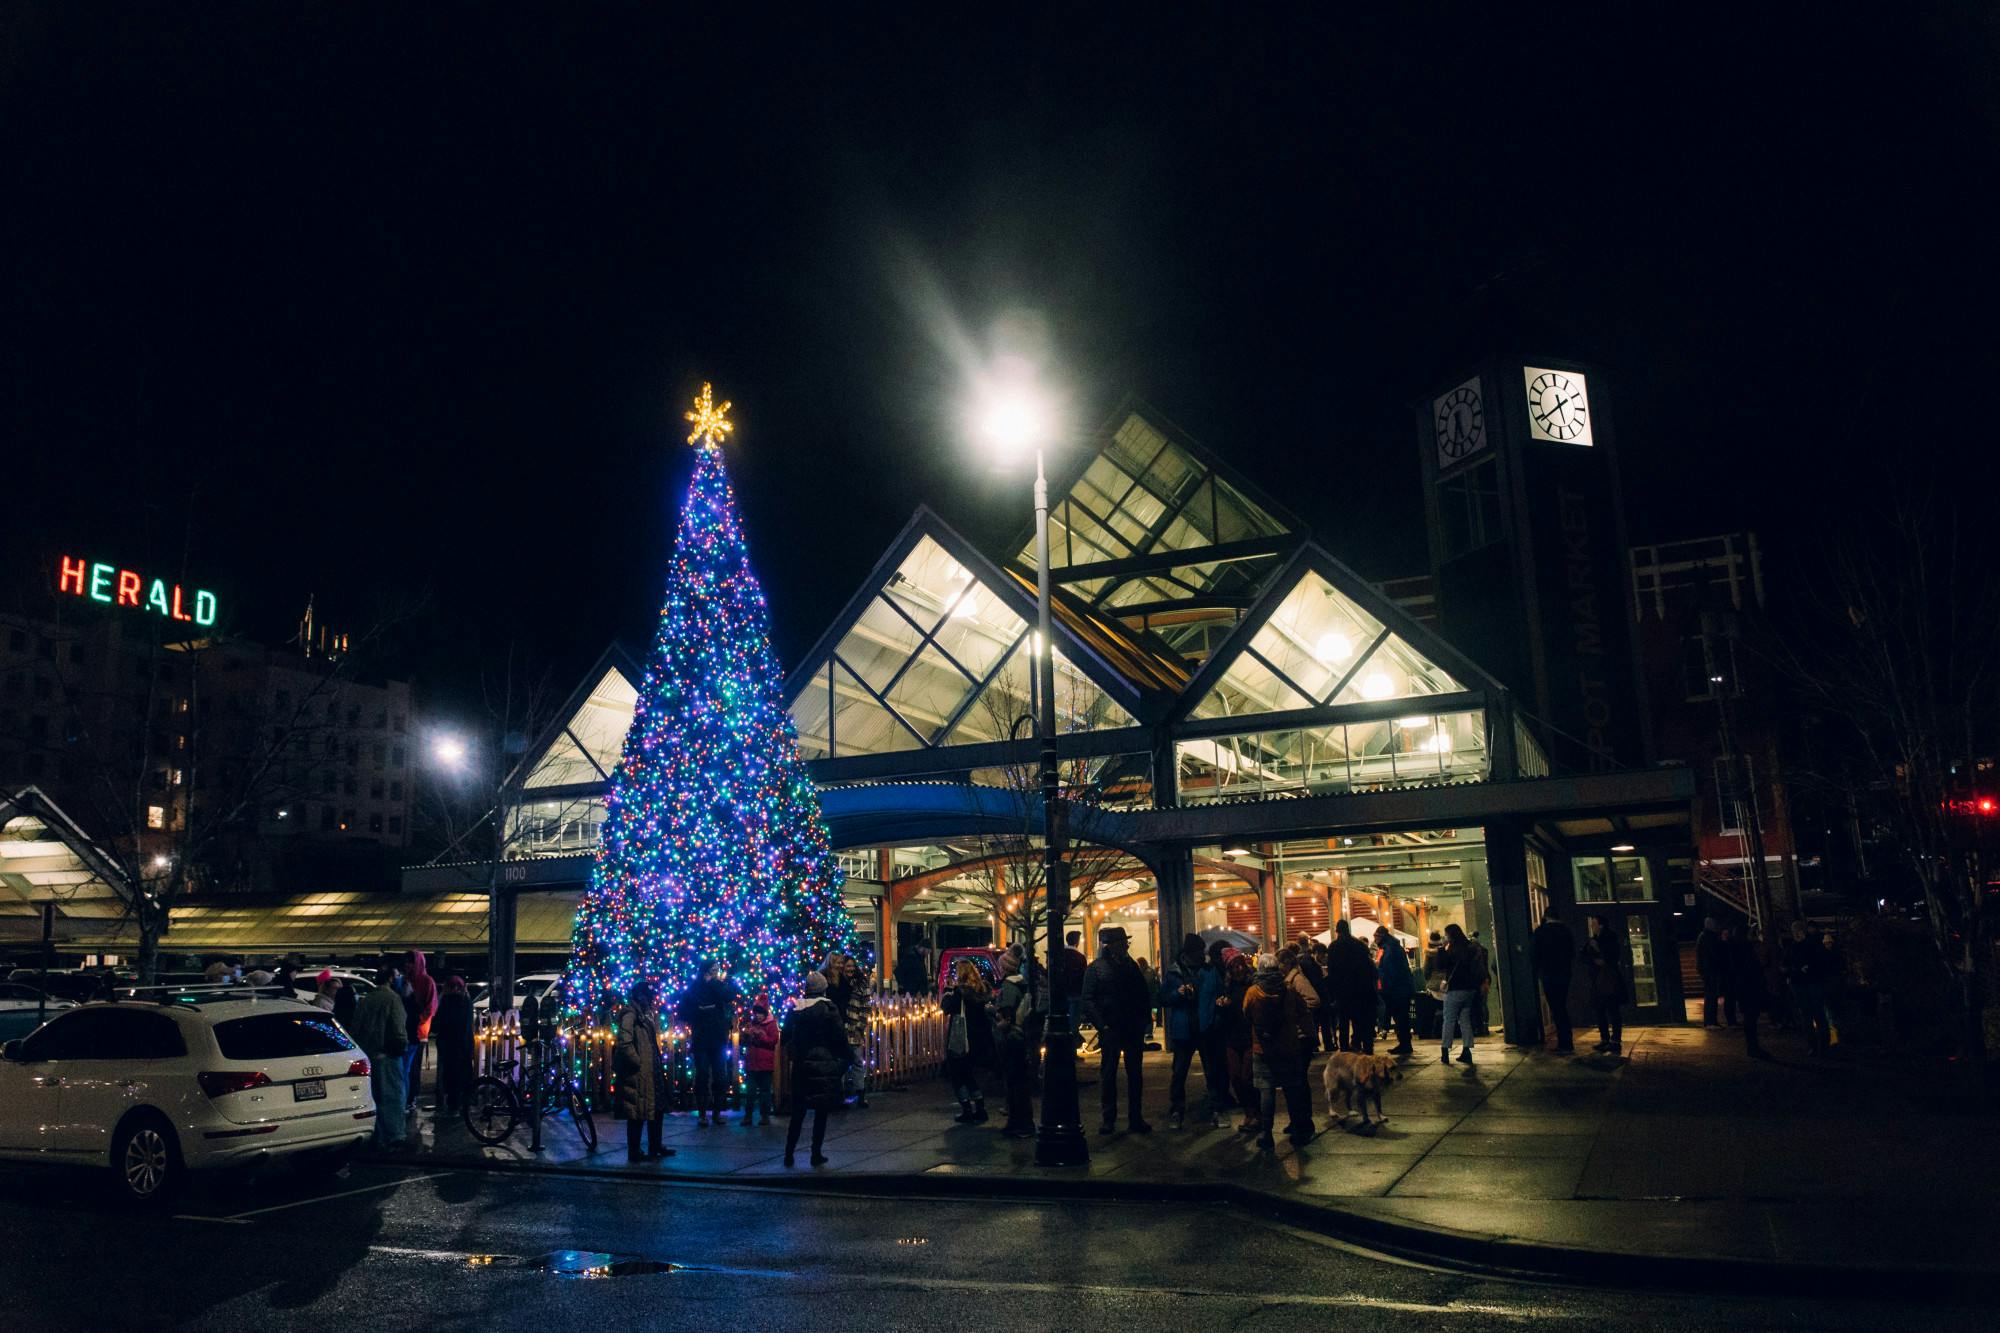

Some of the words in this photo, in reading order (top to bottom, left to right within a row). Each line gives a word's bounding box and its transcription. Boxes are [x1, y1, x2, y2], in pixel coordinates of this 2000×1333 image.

[59, 555, 217, 627] HERALD
[1556, 483, 1603, 655] MARKET
[505, 866, 527, 881] 1100
